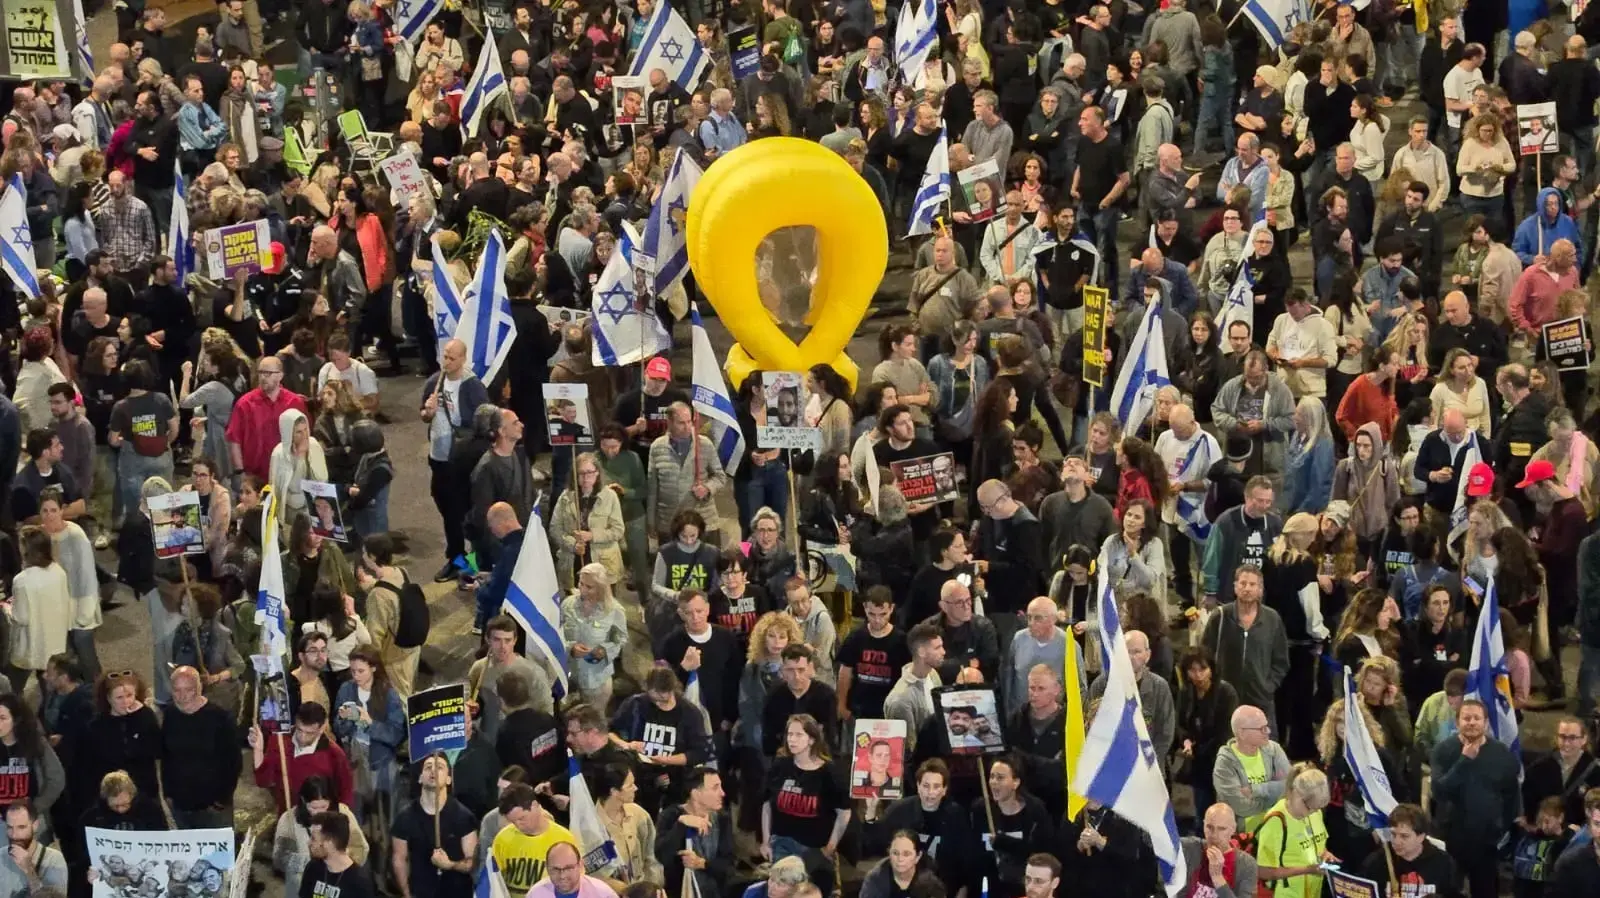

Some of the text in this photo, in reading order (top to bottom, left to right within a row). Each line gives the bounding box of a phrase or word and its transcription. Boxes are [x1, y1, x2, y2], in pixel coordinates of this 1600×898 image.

[10, 32, 54, 48] אשם
[11, 51, 56, 65] במחדל
[224, 230, 255, 246] עסקה
[225, 242, 256, 258] מלאה
[1085, 294, 1101, 309] WAR
[1086, 313, 1099, 329] HAS
[1086, 331, 1095, 346] NO
[432, 697, 464, 707] פיטורי
[440, 705, 464, 714] ראש
[433, 723, 464, 732] פיטורי
[424, 731, 465, 744] הממשלה
[94, 837, 228, 855] ארץ מחוקקי הפרא
[505, 858, 546, 887] NOW
